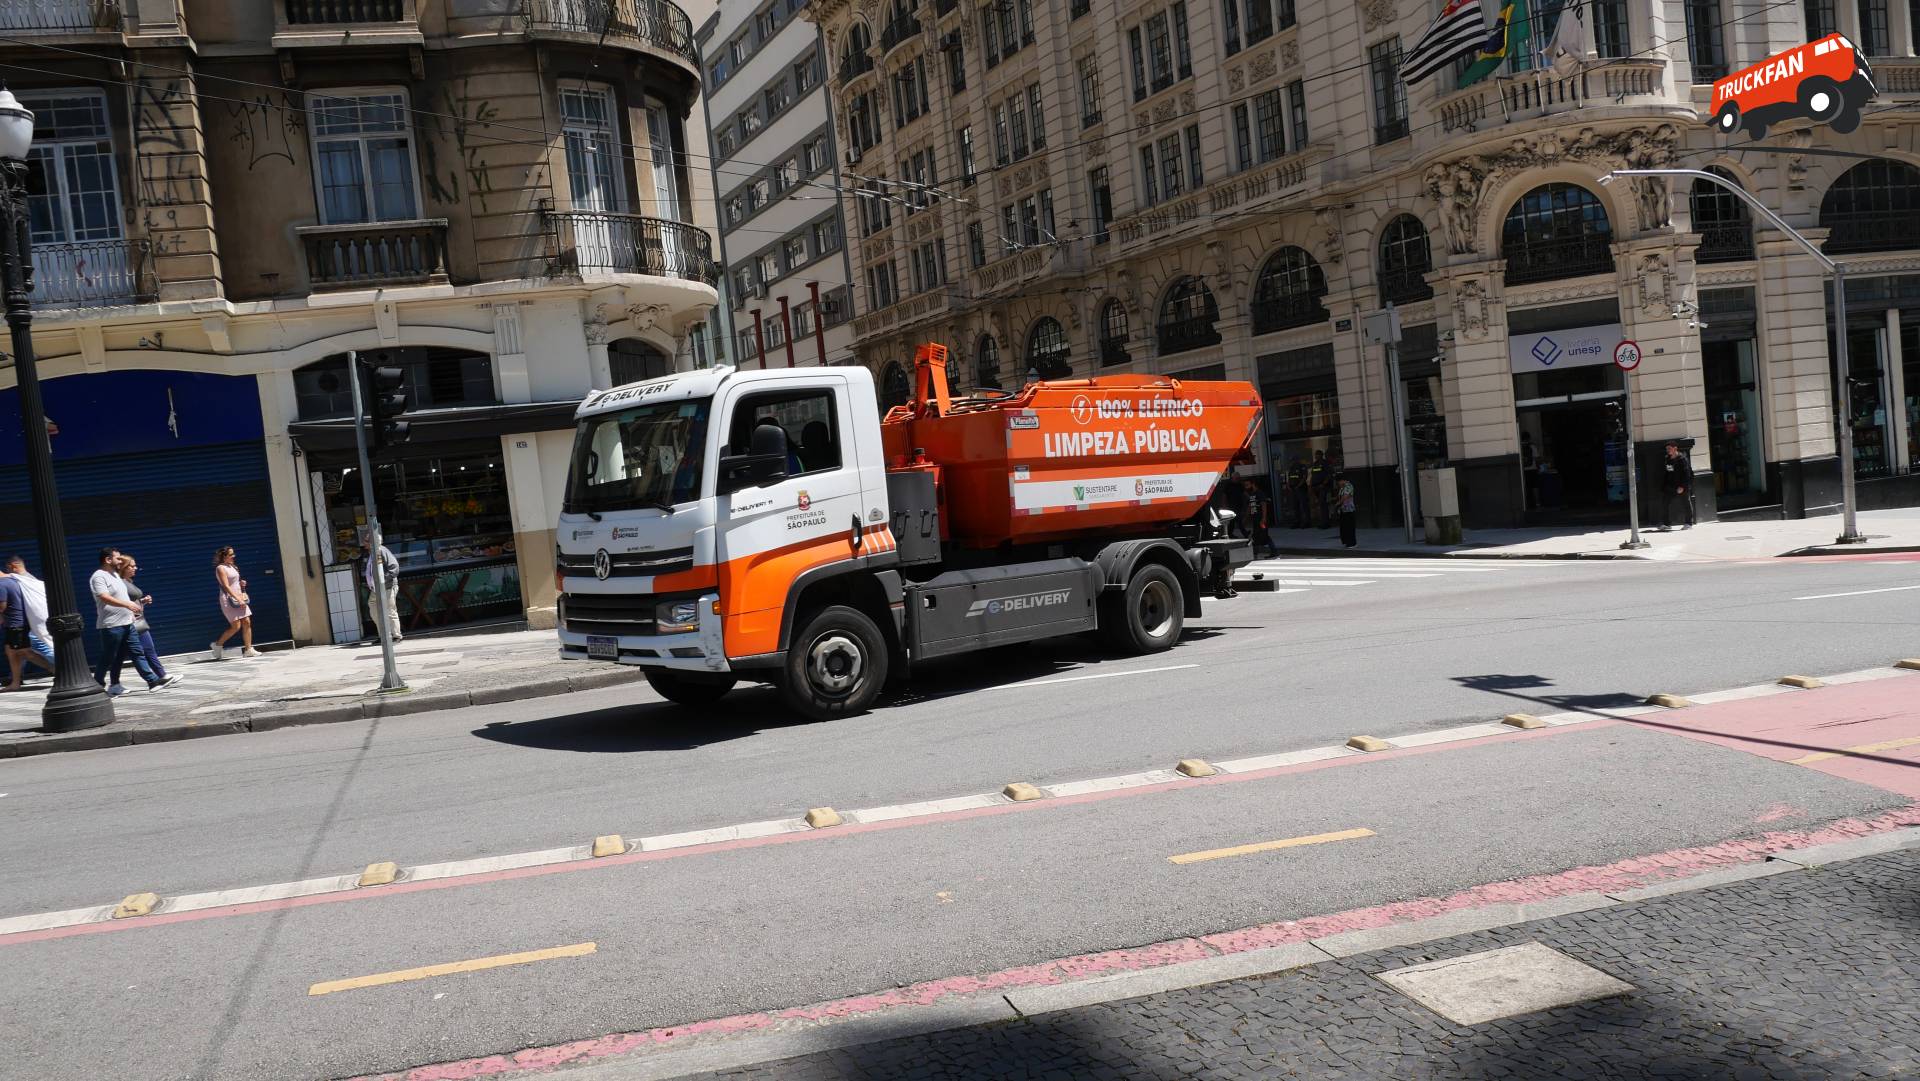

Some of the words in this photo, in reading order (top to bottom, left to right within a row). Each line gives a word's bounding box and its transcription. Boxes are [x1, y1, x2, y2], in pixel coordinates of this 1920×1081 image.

[1568, 345, 1602, 357] unesp
[1095, 399, 1134, 419] 100%
[1138, 394, 1204, 418] ELÉTRICO
[1044, 431, 1130, 458] LIMPEZA
[1134, 422, 1212, 454] PÚBLICA
[1156, 485, 1174, 493] PAULO
[786, 512, 818, 521] PREFEITURA
[787, 520, 802, 530] SÃO
[803, 517, 826, 527] PAULO
[988, 591, 1071, 615] e-DELIVERY
